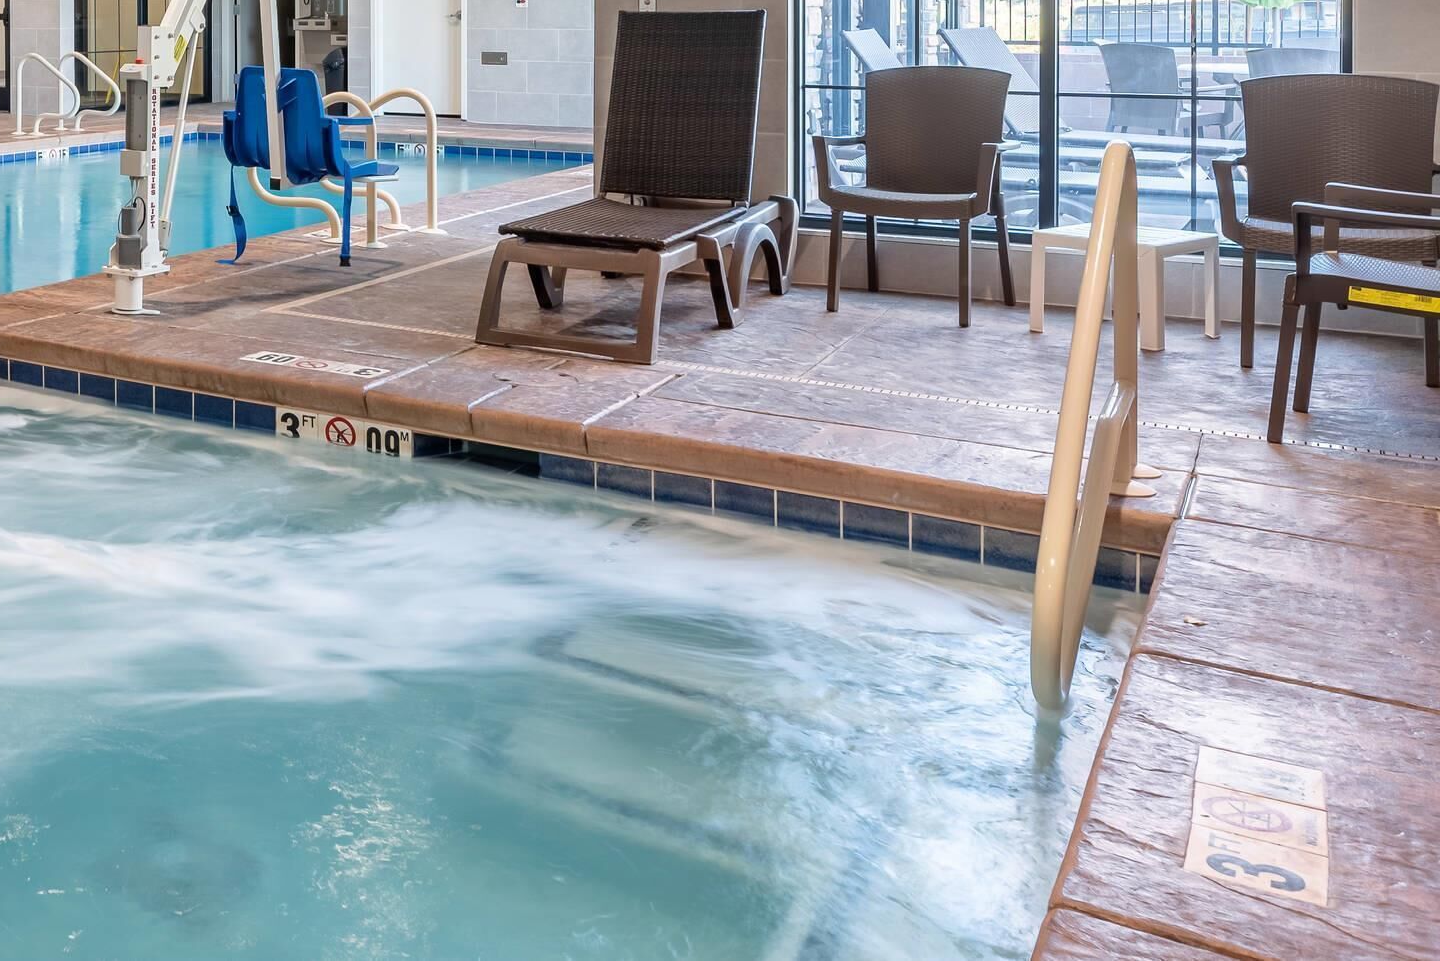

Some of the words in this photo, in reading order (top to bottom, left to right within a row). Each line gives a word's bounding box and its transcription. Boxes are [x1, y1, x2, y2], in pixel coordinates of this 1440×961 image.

[281, 412, 300, 439] 3
[302, 414, 316, 429] FT
[1206, 853, 1306, 892] 3
